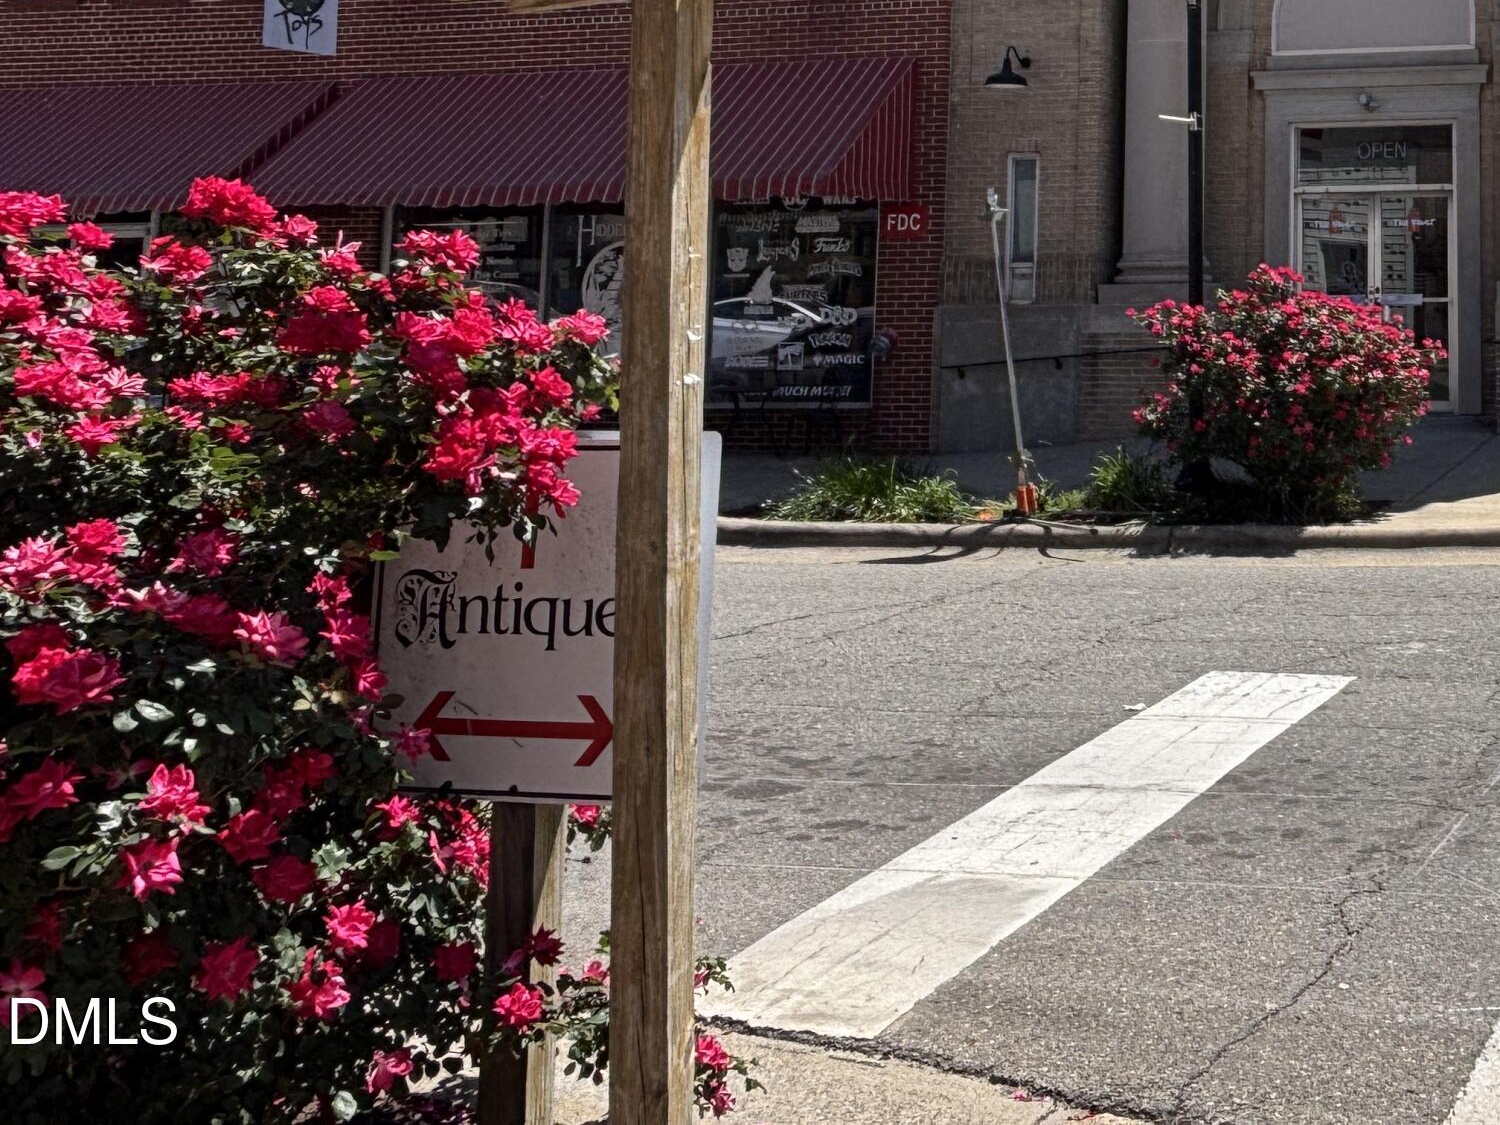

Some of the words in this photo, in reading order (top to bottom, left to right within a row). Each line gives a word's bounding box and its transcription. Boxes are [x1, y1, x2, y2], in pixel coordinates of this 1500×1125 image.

[1357, 141, 1407, 160] OPEN
[887, 213, 921, 231] FDC
[575, 215, 624, 267] HIDDE
[823, 354, 866, 365] MAGIC
[394, 569, 616, 651] Antique
